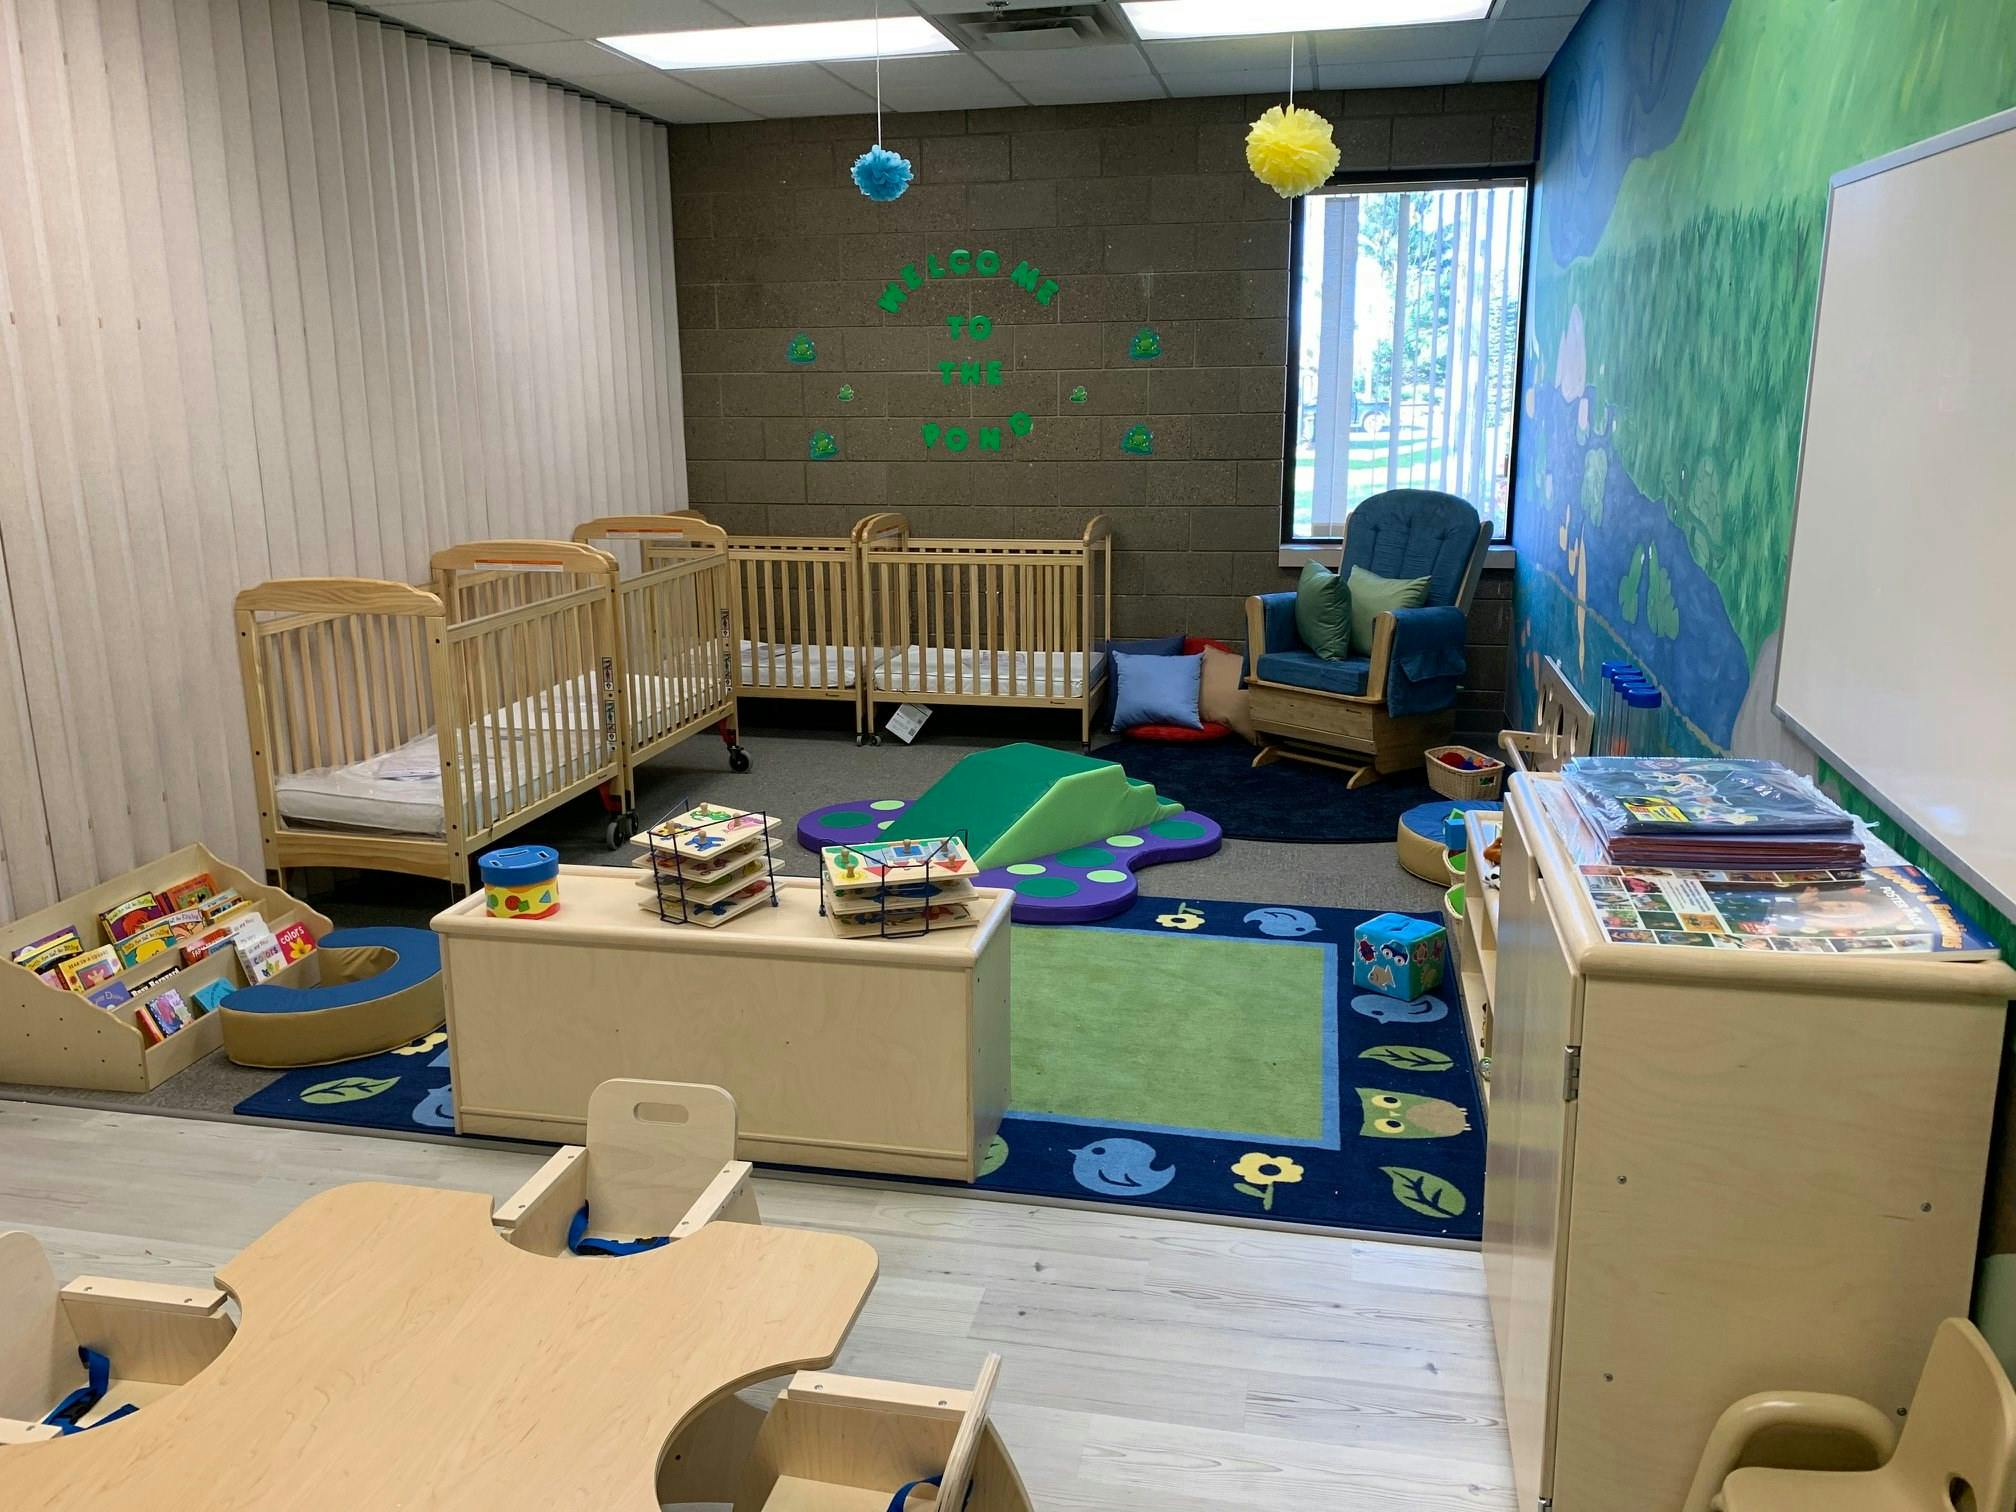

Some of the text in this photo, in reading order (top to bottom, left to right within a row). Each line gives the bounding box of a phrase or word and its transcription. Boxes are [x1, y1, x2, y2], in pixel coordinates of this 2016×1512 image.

[877, 249, 1060, 313] WELCOME
[946, 314, 993, 341] TO
[937, 359, 1003, 385] THE
[921, 410, 1033, 453] POND
[1880, 886, 1909, 909] POSTER
[280, 925, 305, 945] colors
